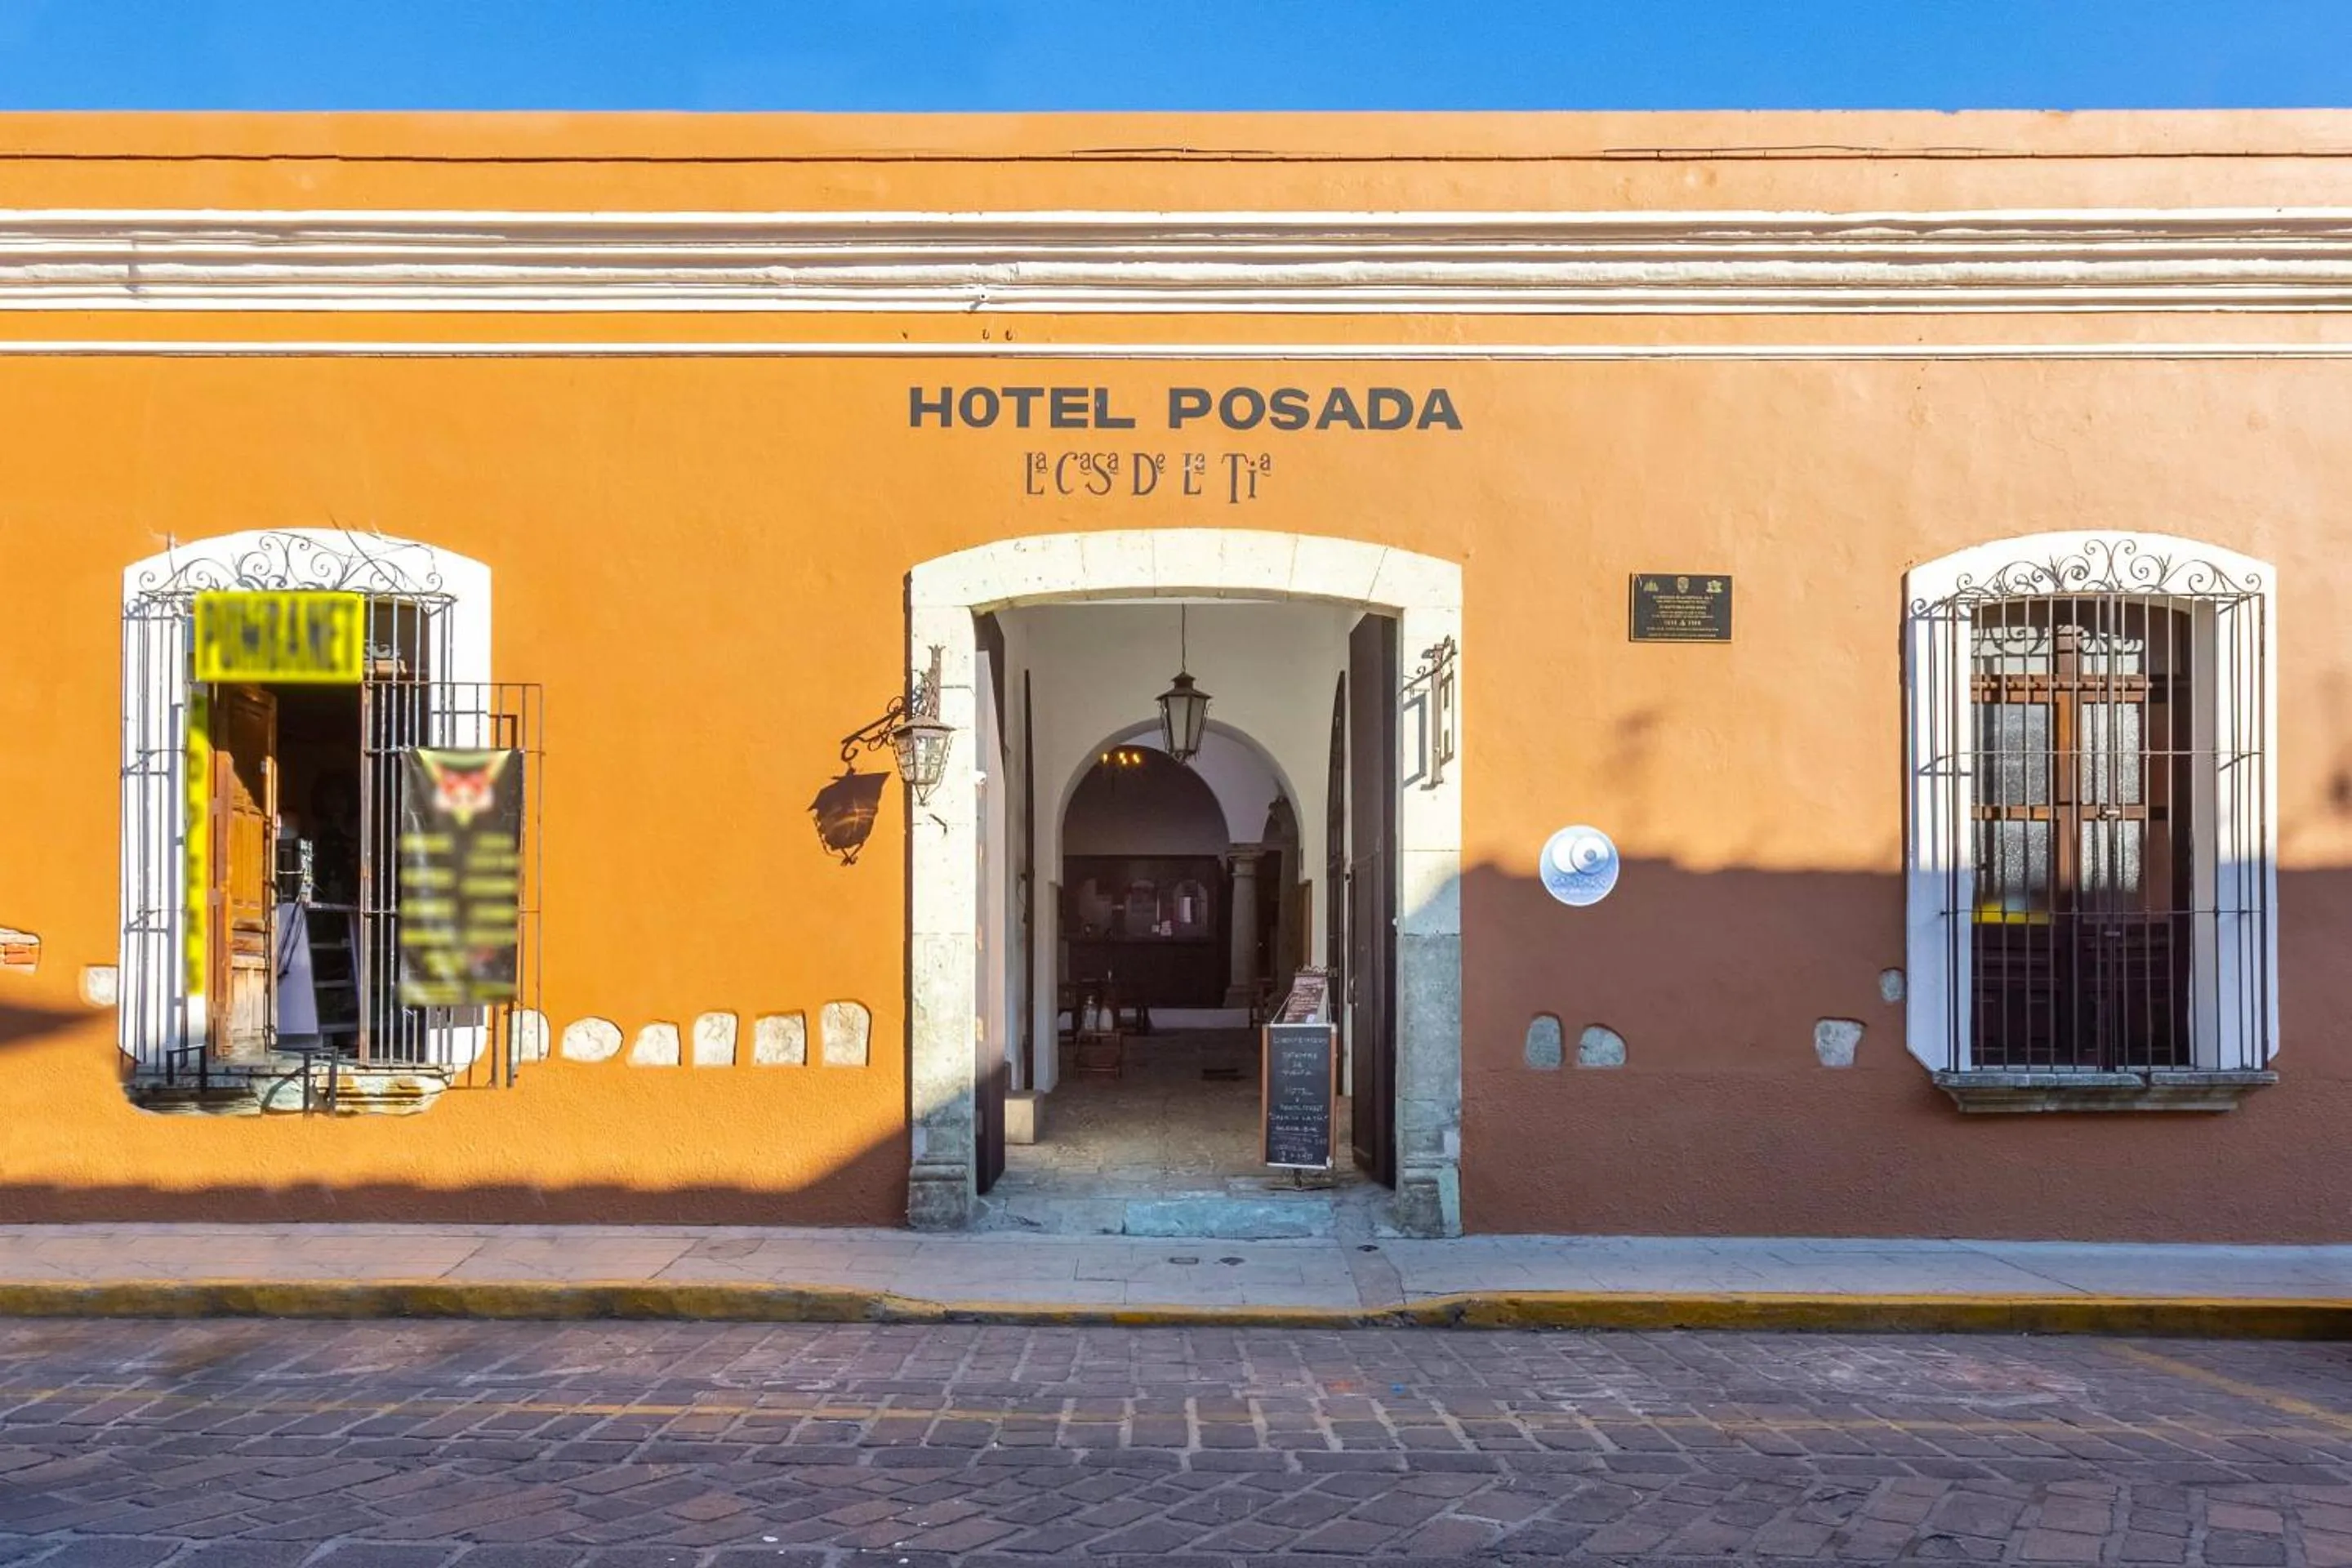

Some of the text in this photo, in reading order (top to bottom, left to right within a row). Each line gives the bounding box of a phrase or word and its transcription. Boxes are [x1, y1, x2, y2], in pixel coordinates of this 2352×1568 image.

[909, 386, 1463, 430] HOTEL POSADA
[1025, 451, 1048, 496] La
[1131, 452, 1166, 496] De
[1183, 452, 1206, 496] La
